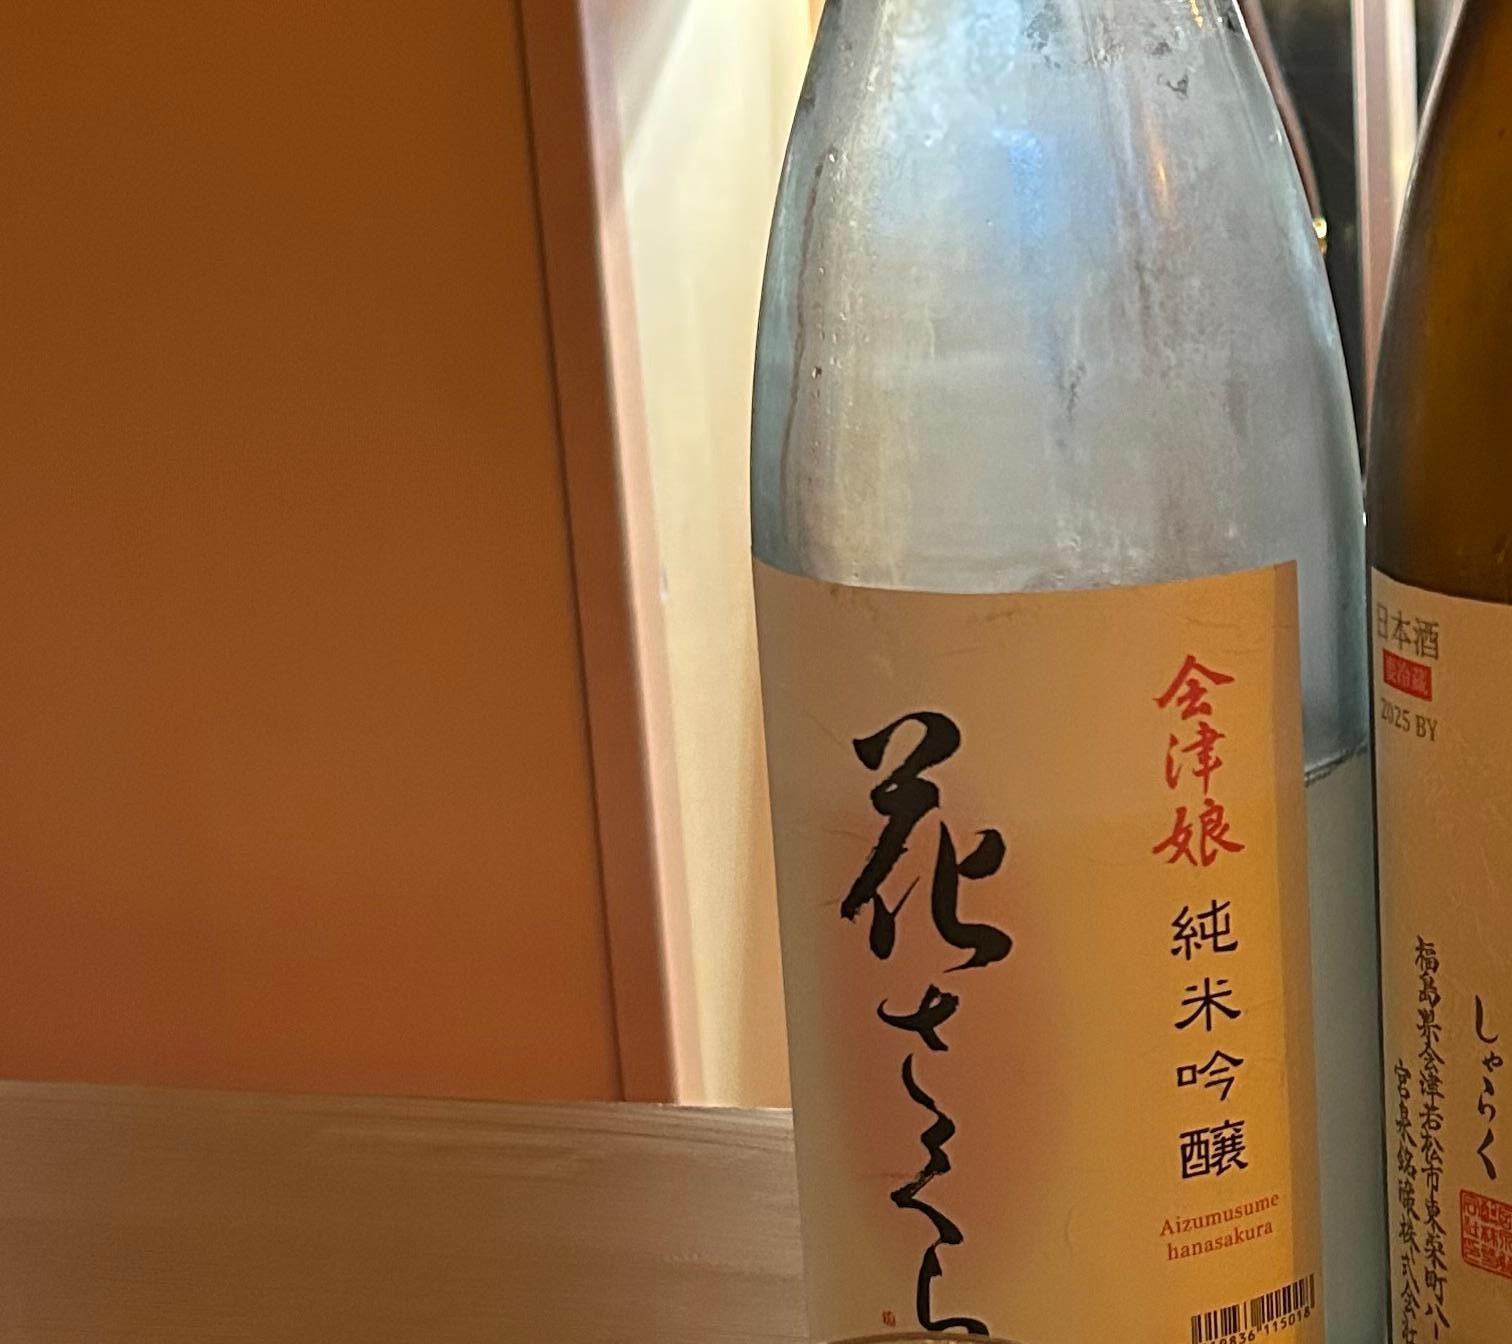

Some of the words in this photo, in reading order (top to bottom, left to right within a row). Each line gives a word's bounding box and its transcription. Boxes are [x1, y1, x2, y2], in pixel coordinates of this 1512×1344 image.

[1376, 600, 1440, 661] 日本酒
[1379, 697, 1411, 733] 2025
[1415, 714, 1439, 742] BY
[1151, 652, 1246, 869] 会津娘
[840, 710, 1014, 1337] 花さくら
[1170, 898, 1249, 1180] 純米吟醸
[1474, 994, 1504, 1181] しゃらく
[1159, 1193, 1281, 1237] Aizumusume
[1166, 1220, 1274, 1261] hanasakura
[1263, 1307, 1311, 1336] 115018
